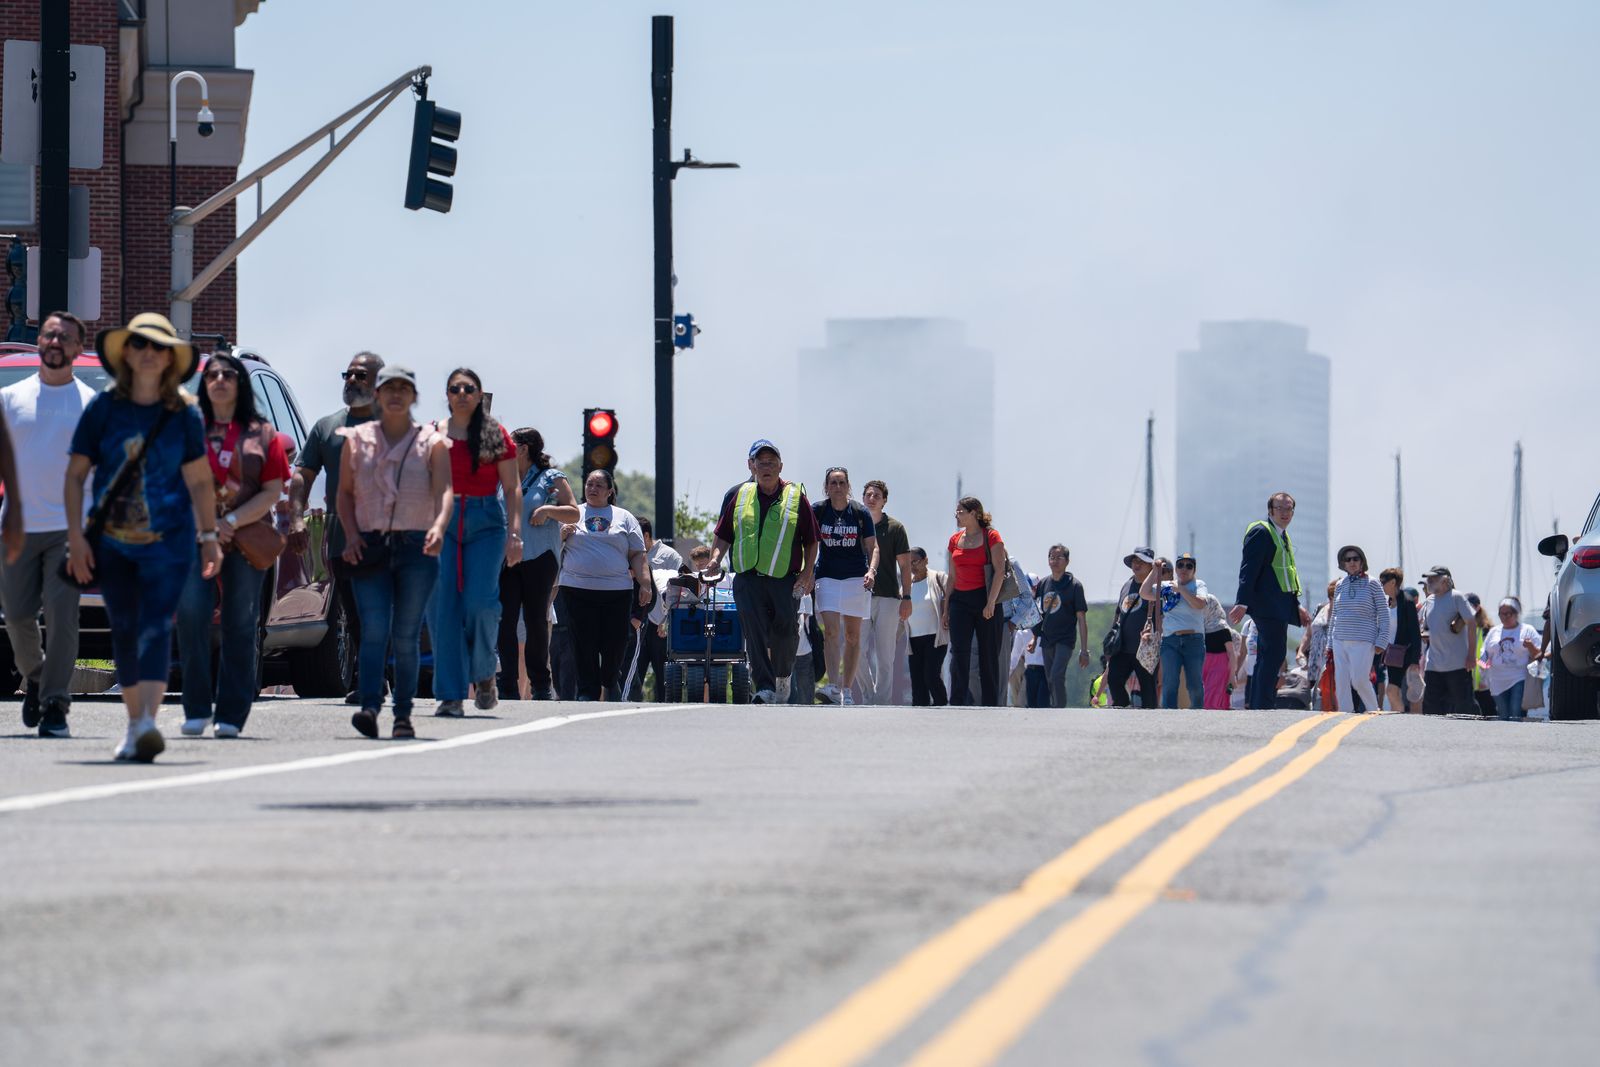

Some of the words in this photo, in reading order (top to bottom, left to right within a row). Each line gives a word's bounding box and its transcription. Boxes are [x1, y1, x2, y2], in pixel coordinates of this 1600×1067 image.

[821, 524, 833, 534] ONE
[833, 525, 858, 534] NATION
[823, 538, 841, 547] NDER
[842, 538, 857, 547] GOD
